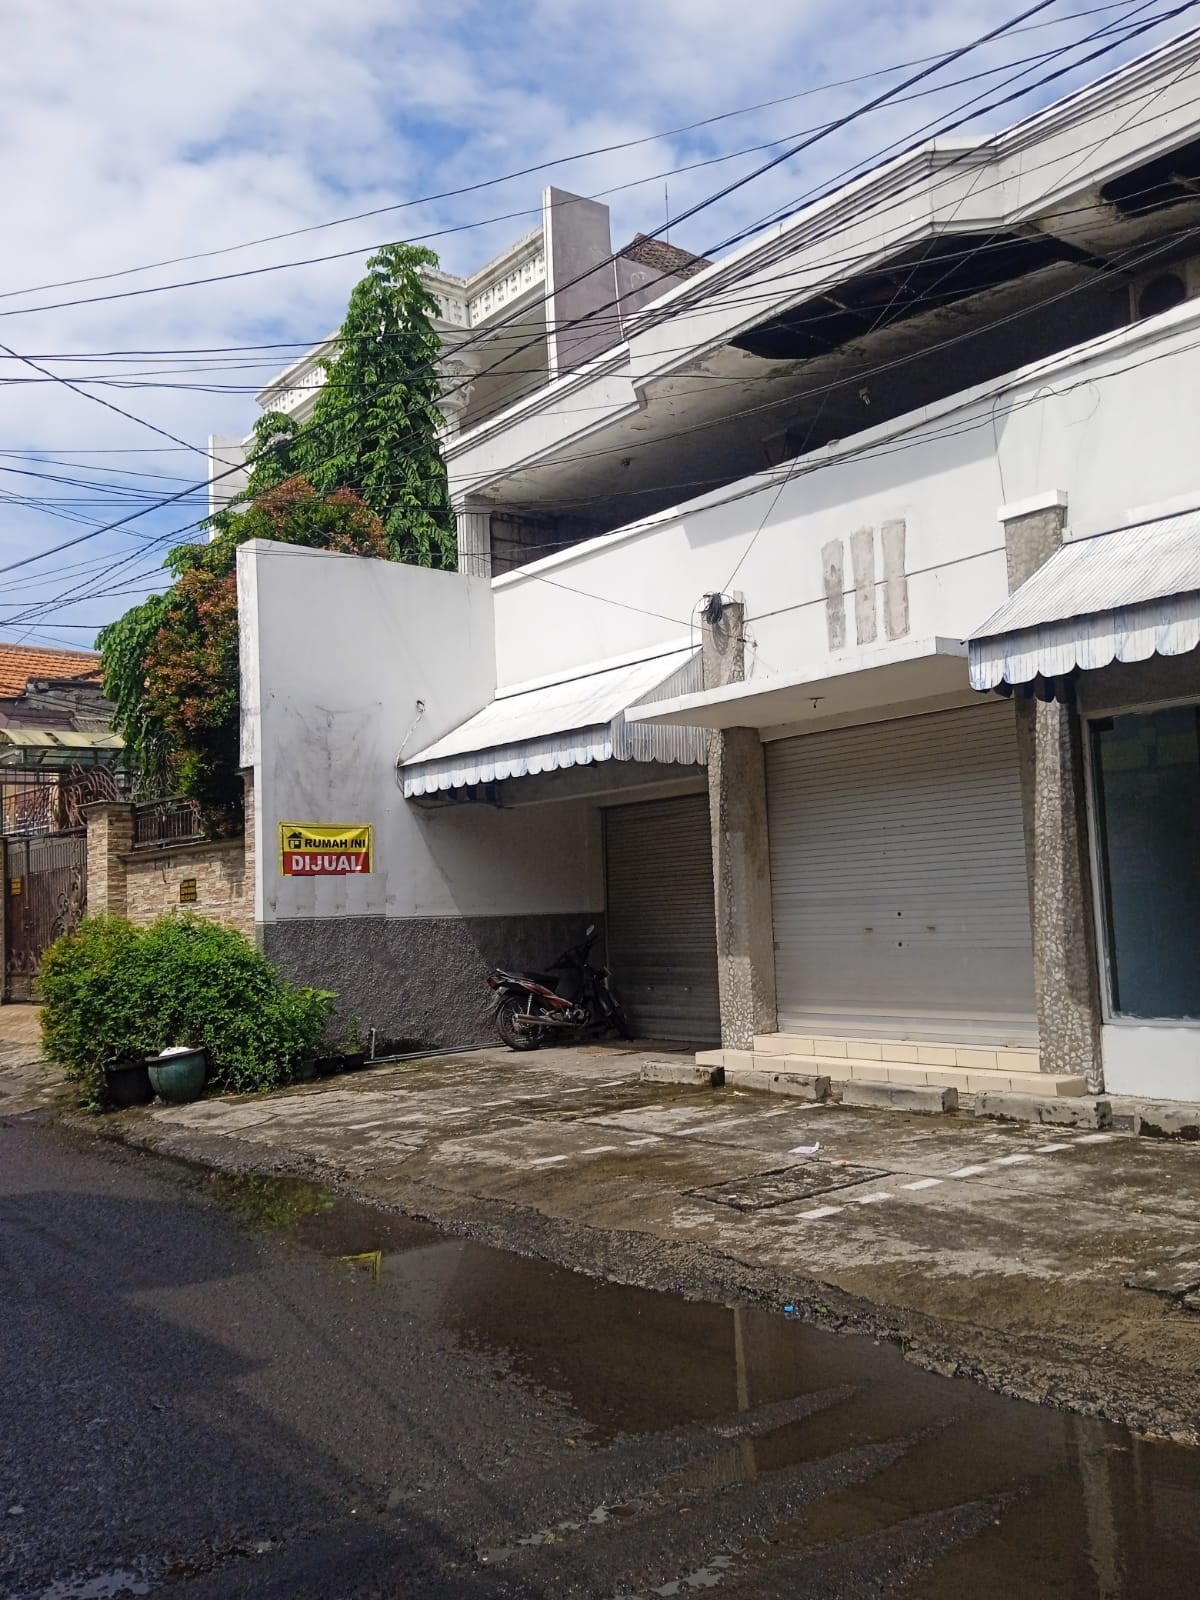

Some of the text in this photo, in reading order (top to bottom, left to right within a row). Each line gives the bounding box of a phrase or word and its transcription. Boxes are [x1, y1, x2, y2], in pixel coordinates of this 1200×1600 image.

[305, 839, 365, 848] RUMAH INI
[292, 855, 362, 871] DIJUAL
